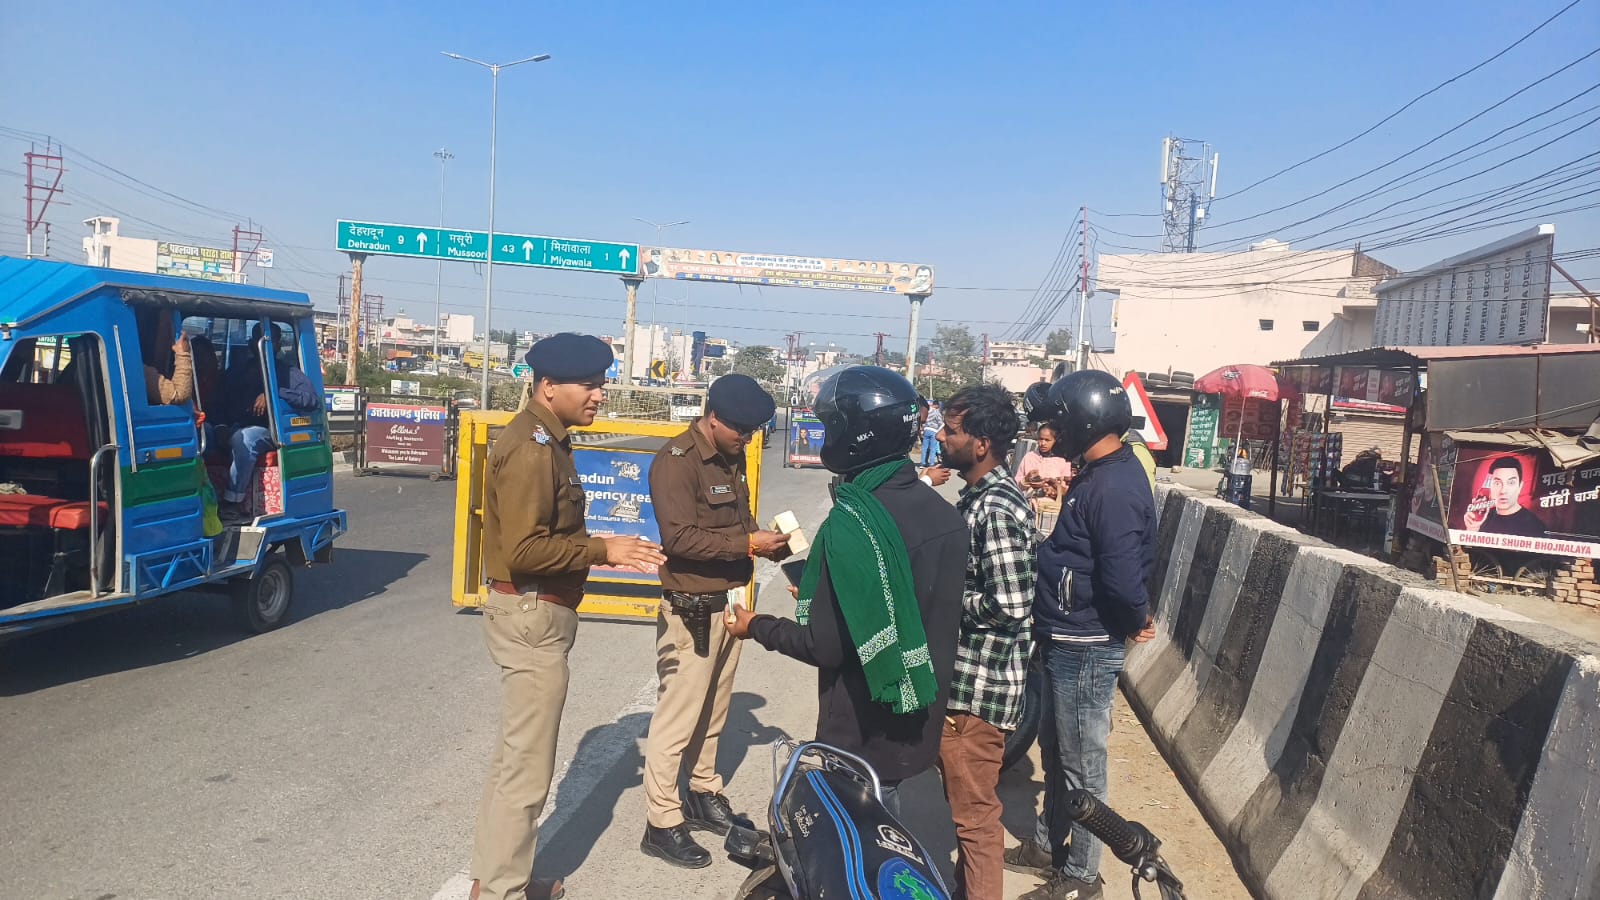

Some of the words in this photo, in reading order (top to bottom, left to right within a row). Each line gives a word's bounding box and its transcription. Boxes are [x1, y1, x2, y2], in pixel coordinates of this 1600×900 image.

[349, 223, 384, 240] देहरादून
[347, 239, 390, 251] Dehradun
[397, 235, 405, 245] 9
[449, 232, 473, 247] मसूरी
[447, 247, 488, 259] Mussoori
[501, 244, 515, 254] 43
[550, 239, 591, 255] मियांवाला
[550, 255, 592, 268] Miyawala
[604, 252, 609, 261] 1
[370, 408, 412, 418] उत्तराखण्ड
[413, 407, 440, 423] पुलिस
[856, 430, 875, 443] MX-1
[584, 490, 627, 503] gency
[1540, 489, 1571, 508] बॉडी
[1459, 533, 1499, 546] CHAMOLI
[1502, 538, 1532, 549] SHUDH
[1534, 542, 1592, 556] BHOJNALAYA
